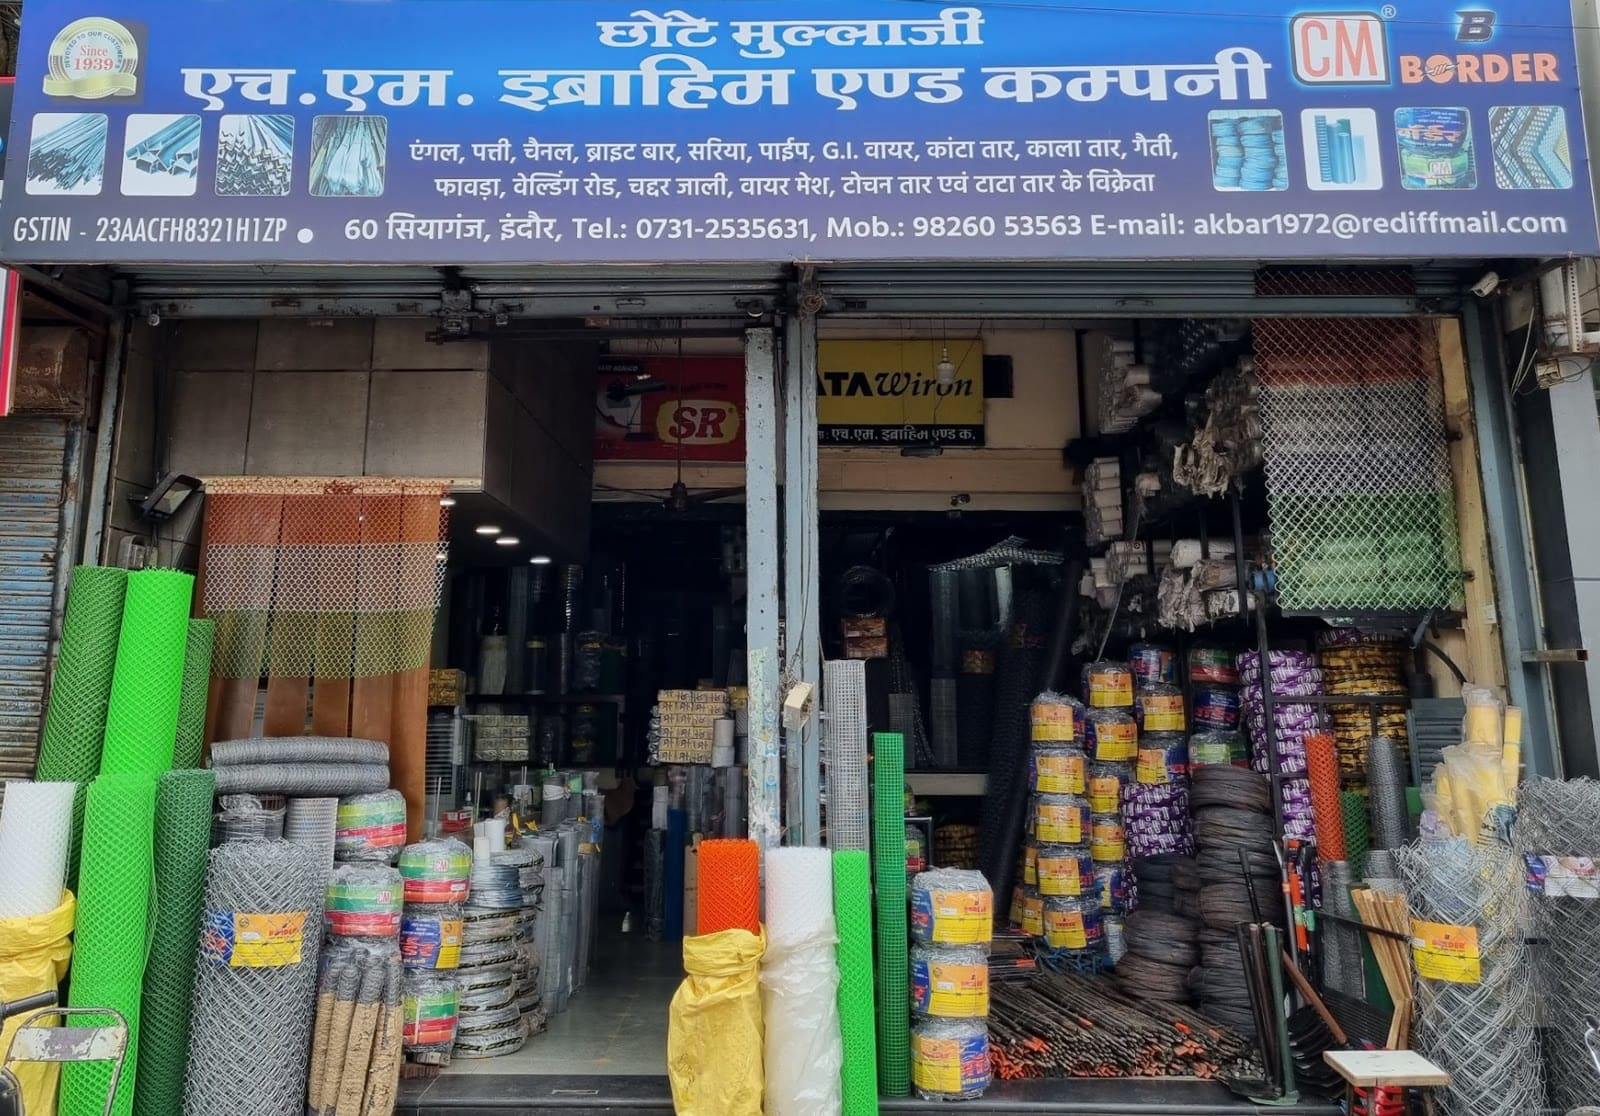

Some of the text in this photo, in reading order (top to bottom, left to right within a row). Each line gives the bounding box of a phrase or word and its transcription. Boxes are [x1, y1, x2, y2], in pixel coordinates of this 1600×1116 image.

[596, 7, 985, 59] छोटे मुल्लाजी
[1300, 20, 1378, 77] CM
[74, 57, 115, 71] 1939
[80, 44, 109, 57] Since
[498, 53, 796, 111] इब्राहिम
[811, 67, 965, 110] एण्ड
[981, 47, 1272, 103] कम्पनी
[1400, 53, 1560, 84] BORDER
[409, 132, 1178, 164] एंगल, पत्ती, चैनल, ब्राइट बार, सरिया, पाईप, G.I. वायर, कांटा तार, काला तार, गैती,
[434, 168, 1155, 201] फावड़ा, वेल्डिंग रोड, चद्दर जाली, वायर मेश, टोचन तार एवं टाटा तार के विक्रेता
[13, 216, 71, 242] GSTIN
[95, 217, 288, 242] 23AACFH8321H1ZP
[344, 210, 1567, 243] 60 सियागंज, इंदौर, Tel.: 0731-2535631, Mob.: 98260 53563 E-mail: akbar1972@rediffmail.com
[669, 406, 726, 439] SR
